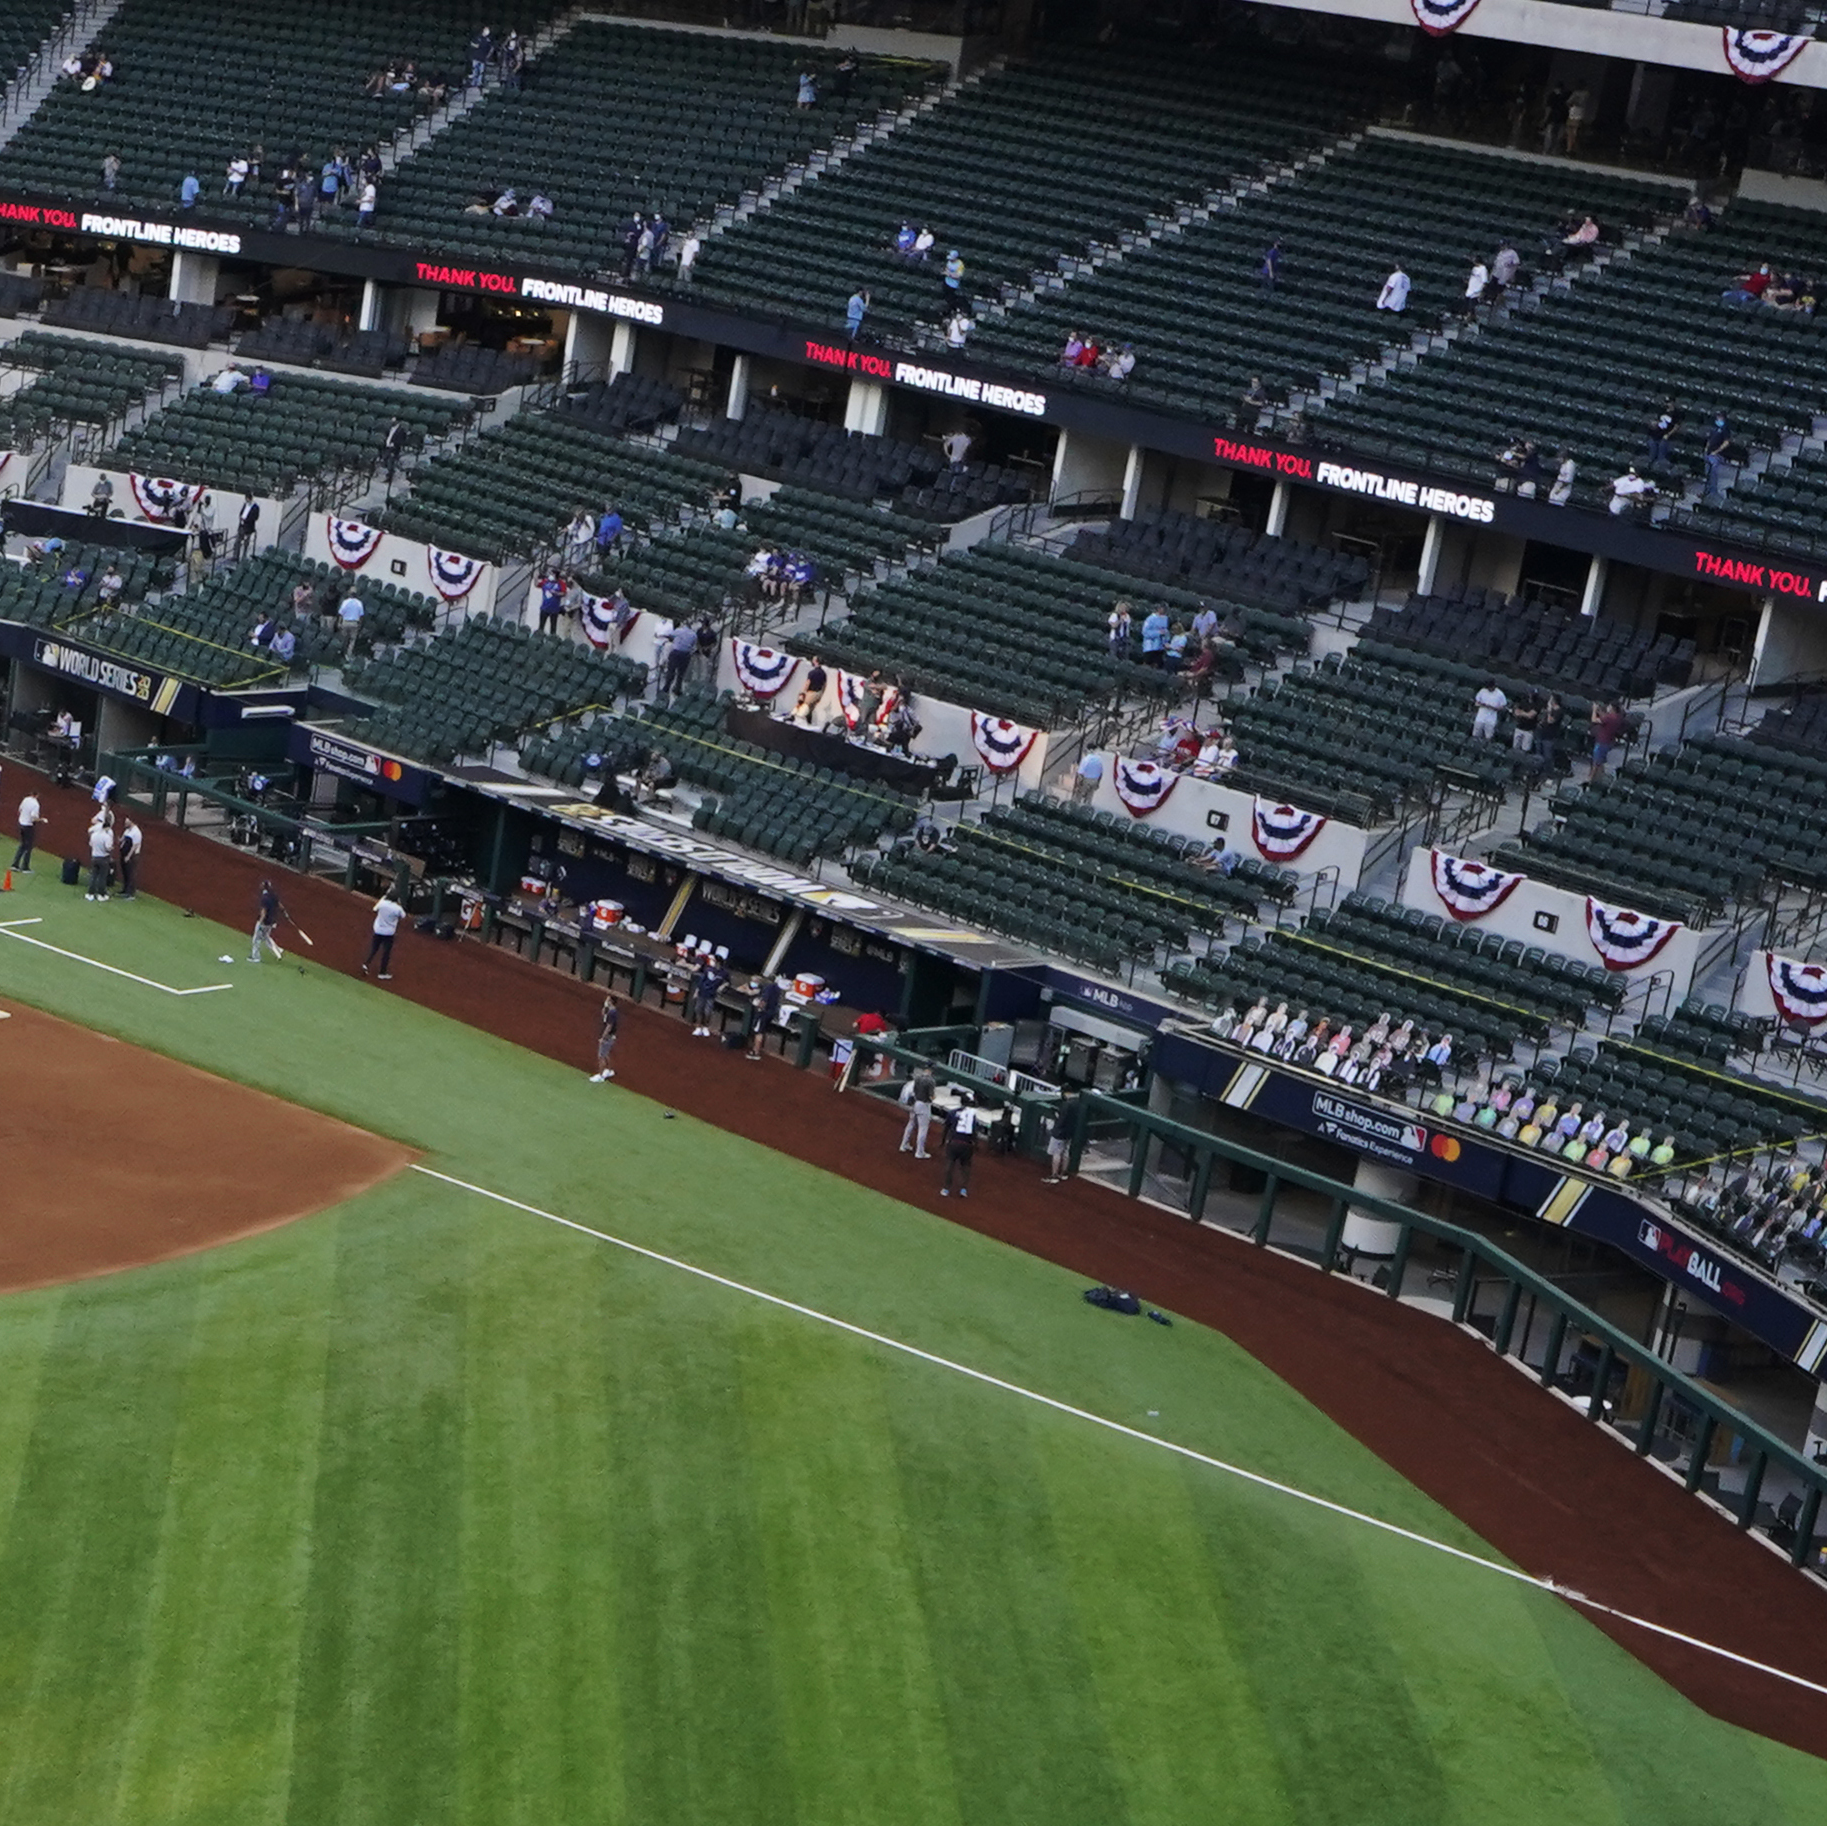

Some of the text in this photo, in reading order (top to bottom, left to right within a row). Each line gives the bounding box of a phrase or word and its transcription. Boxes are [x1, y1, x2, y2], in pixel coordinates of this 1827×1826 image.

[43, 208, 77, 228] YOU.
[81, 213, 172, 243] FRONTLINE
[174, 228, 241, 254] HEROES
[415, 263, 663, 325] THANK YOU. FRONTLINE HEROES
[805, 341, 1046, 417] THANK YOU. FRONTLINE HEROES
[1213, 438, 1495, 524] THANK YOU. FRONTLINE HEROES
[1696, 551, 1765, 587] THANK
[1768, 568, 1812, 598] YOU.
[58, 644, 138, 696] WORLD SERIES
[1093, 988, 1120, 1008] MLB
[1316, 1095, 1401, 1141] MLBshop.com
[1336, 1127, 1369, 1149] Fanatics
[1368, 1140, 1414, 1165] Experience
